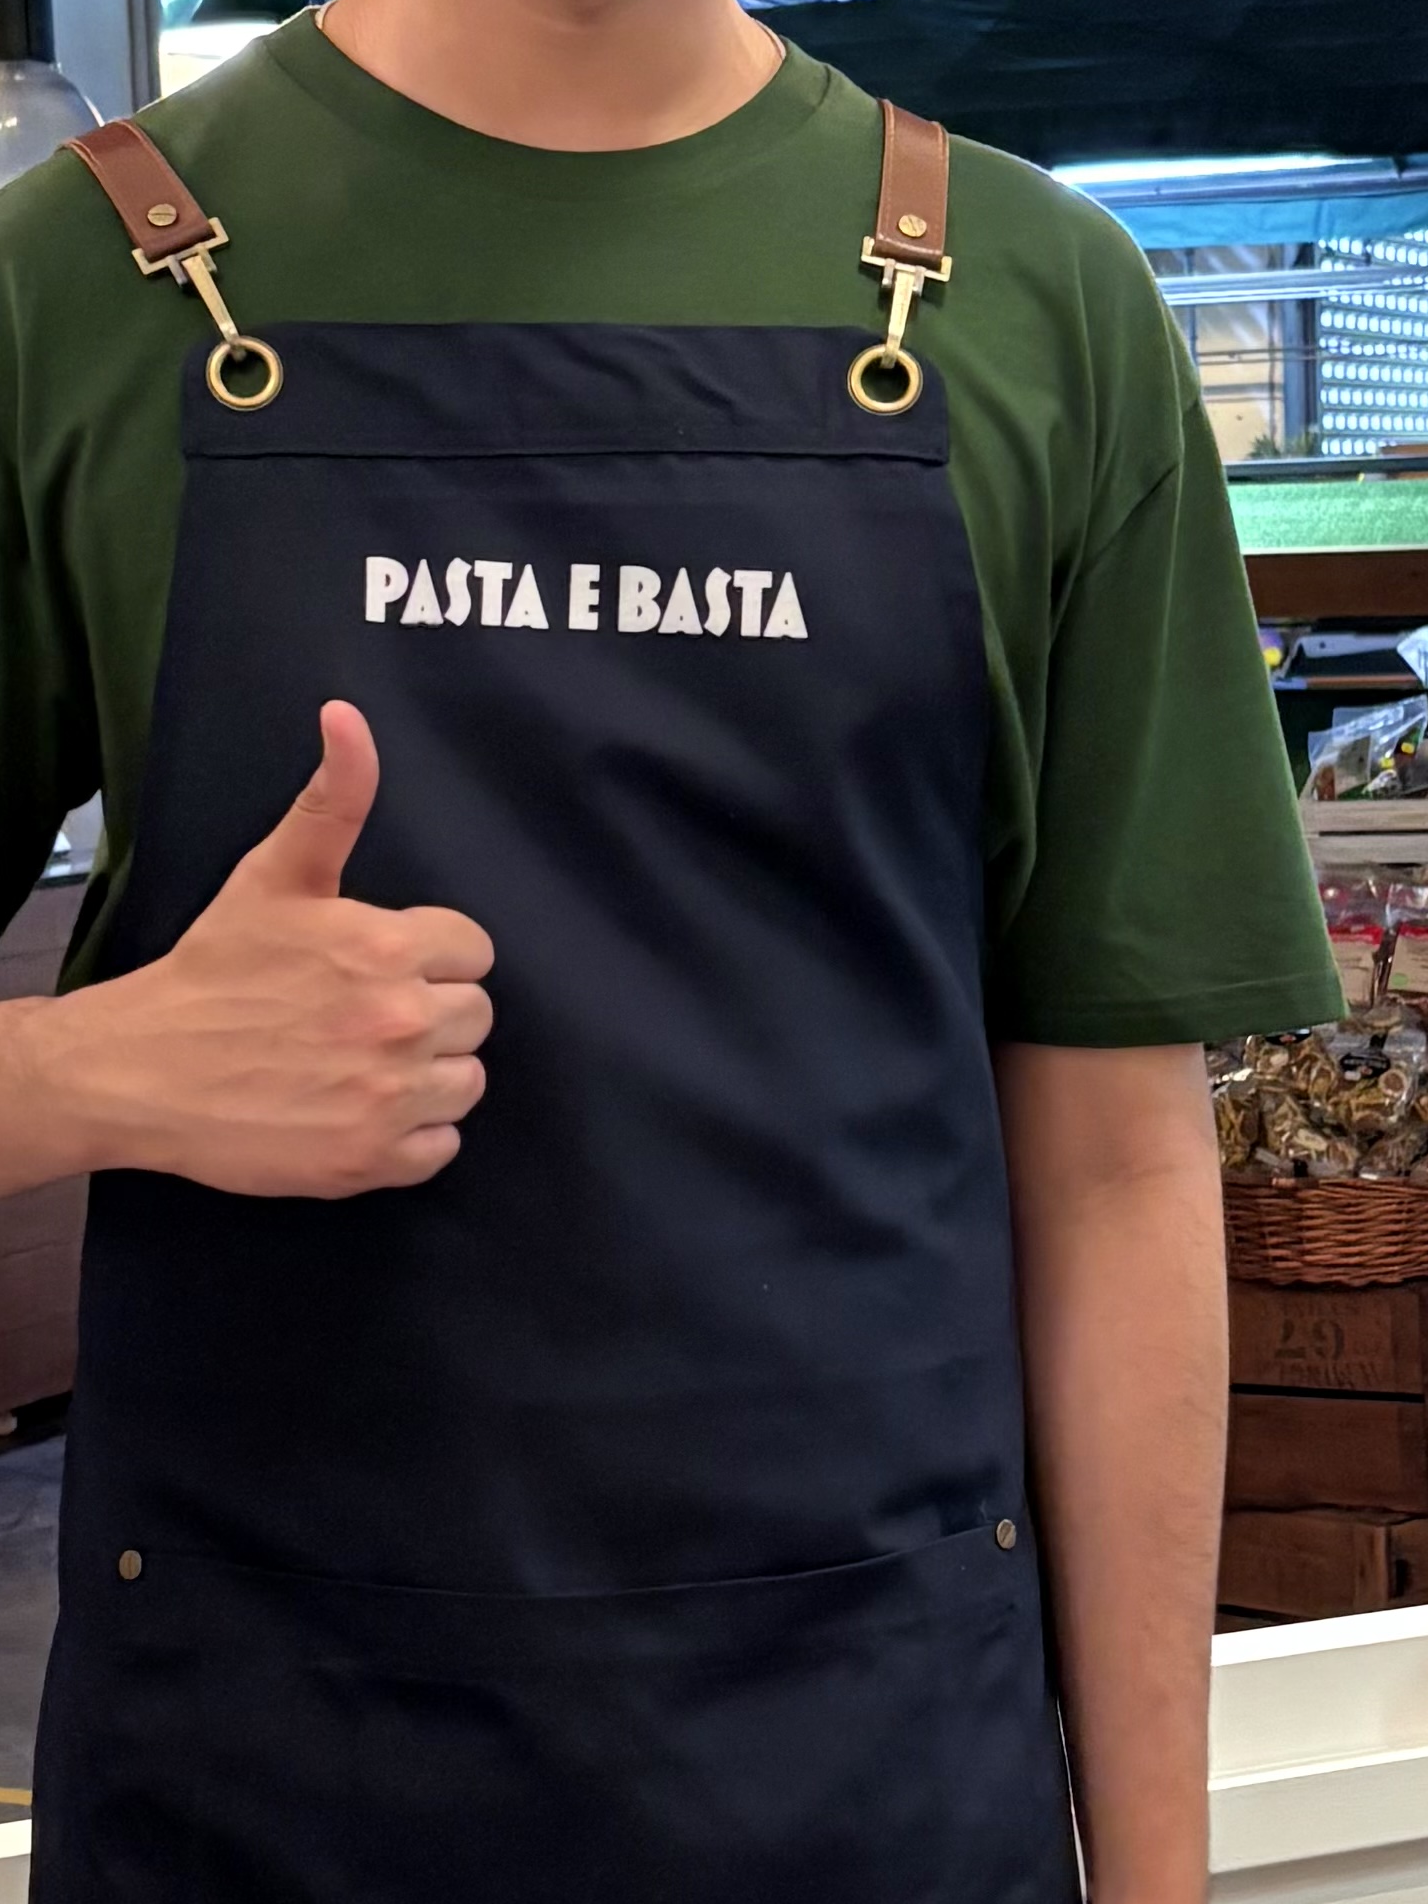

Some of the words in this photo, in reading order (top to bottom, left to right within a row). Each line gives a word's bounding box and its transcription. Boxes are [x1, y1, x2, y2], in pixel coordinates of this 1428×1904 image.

[364, 556, 550, 630] PASTA
[568, 563, 601, 631] E
[617, 565, 809, 640] BASTA
